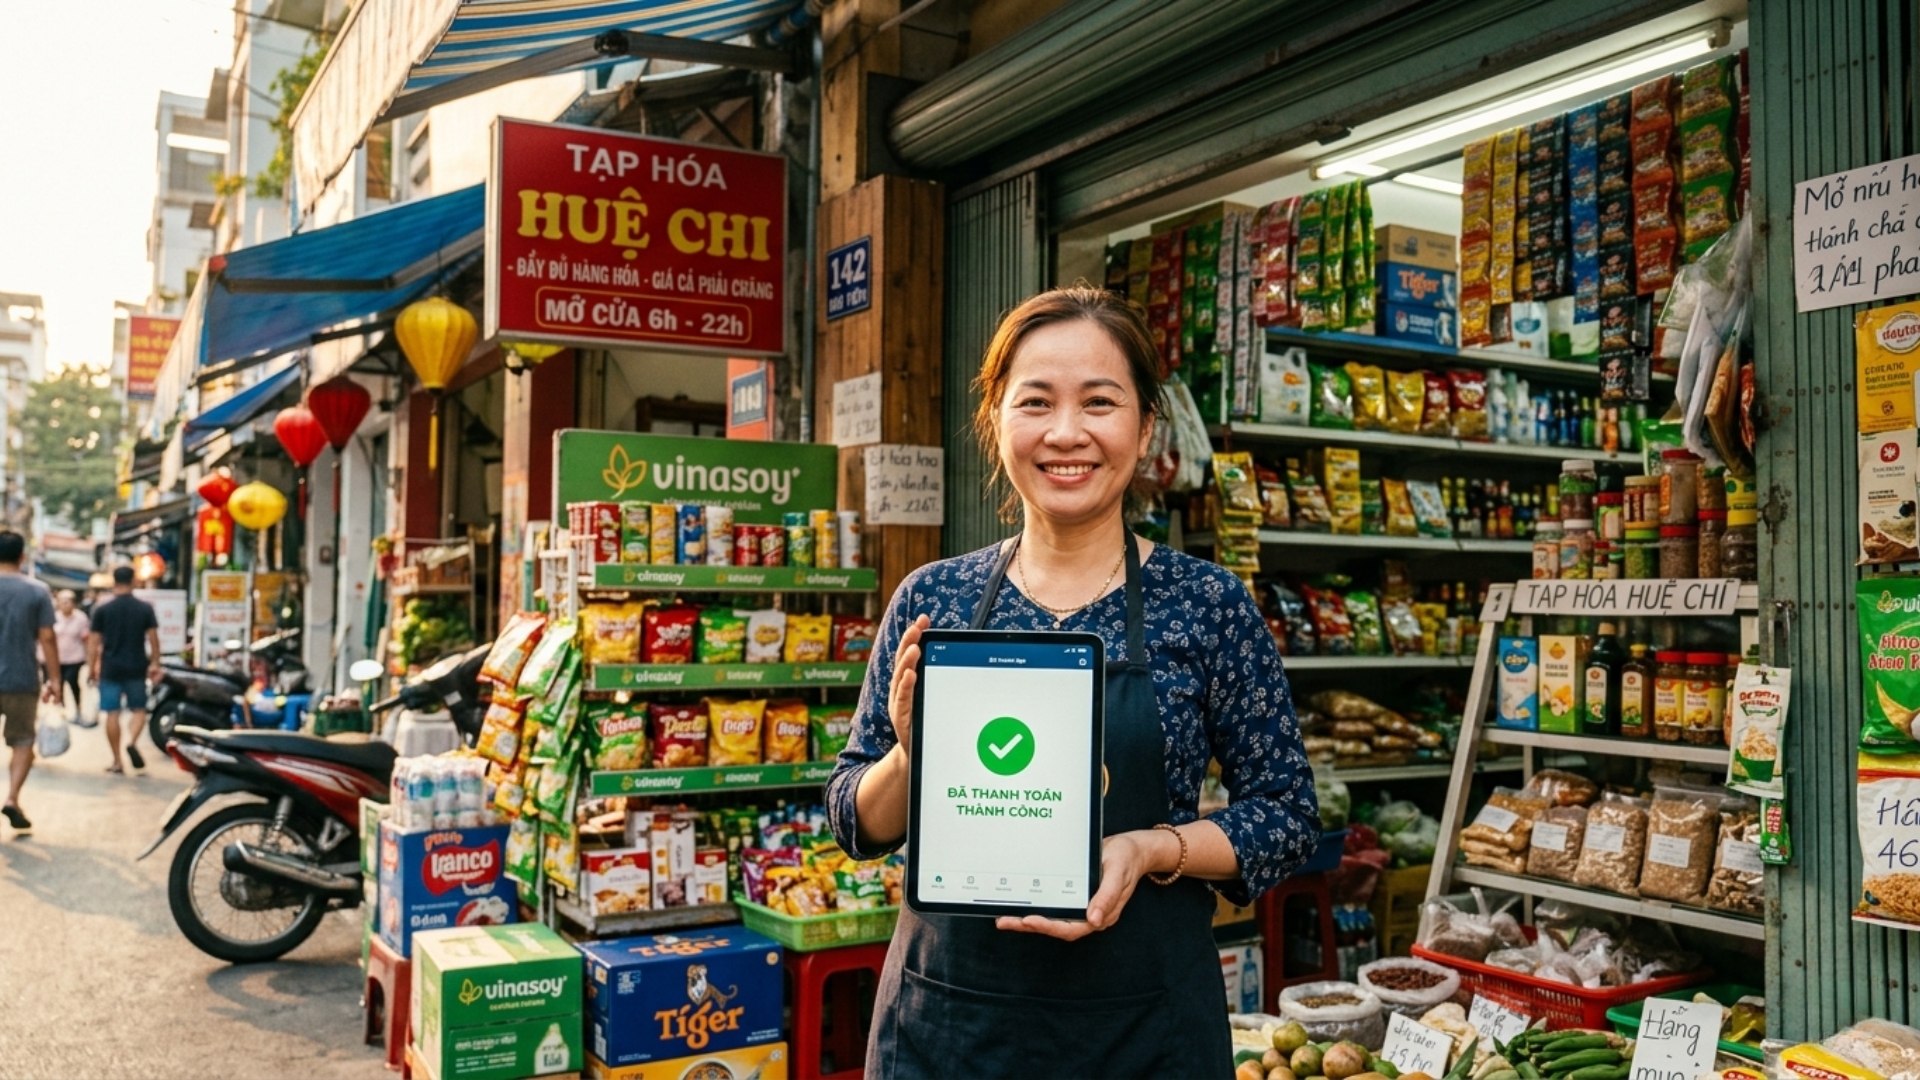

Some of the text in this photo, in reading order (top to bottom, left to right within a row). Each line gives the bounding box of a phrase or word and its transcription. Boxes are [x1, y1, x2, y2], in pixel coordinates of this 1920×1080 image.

[566, 143, 727, 191] TẠP HÓA
[517, 186, 771, 262] HUỆ CHI
[612, 263, 640, 287] HÓA
[831, 248, 867, 290] 142
[648, 308, 678, 331] 6h
[701, 313, 744, 337] 22h
[653, 455, 792, 505] vinasoy
[971, 788, 1019, 801] THANH
